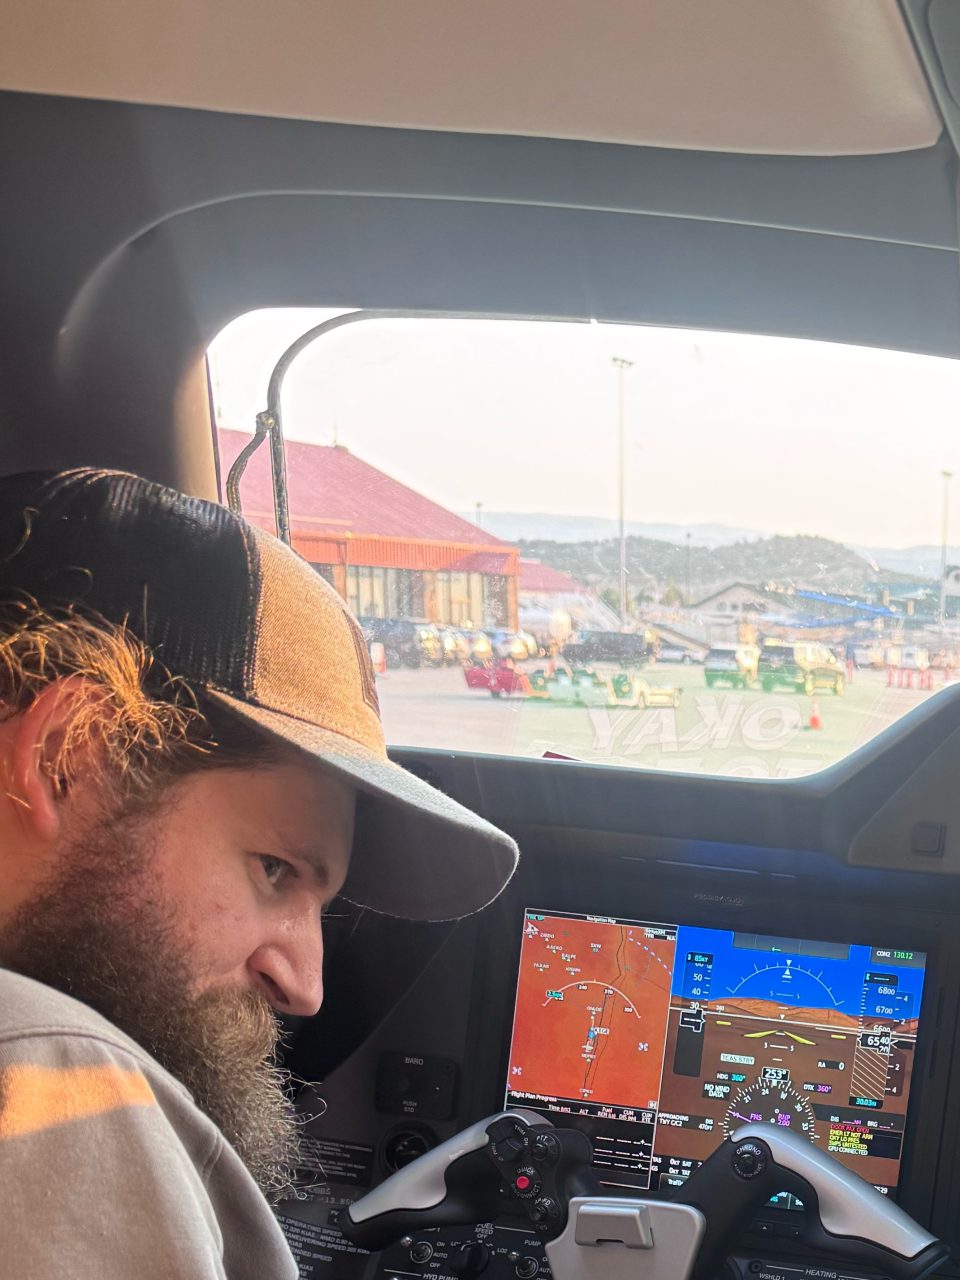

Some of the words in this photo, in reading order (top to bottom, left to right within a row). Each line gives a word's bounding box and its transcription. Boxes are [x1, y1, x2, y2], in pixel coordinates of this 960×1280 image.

[893, 951, 913, 960] 130.12
[693, 973, 703, 981] 50
[691, 987, 702, 996] 40
[877, 986, 895, 995] 6800
[875, 1006, 893, 1015] 6700
[759, 1272, 781, 1280] WSHLD
[805, 1268, 837, 1279] HEATING
